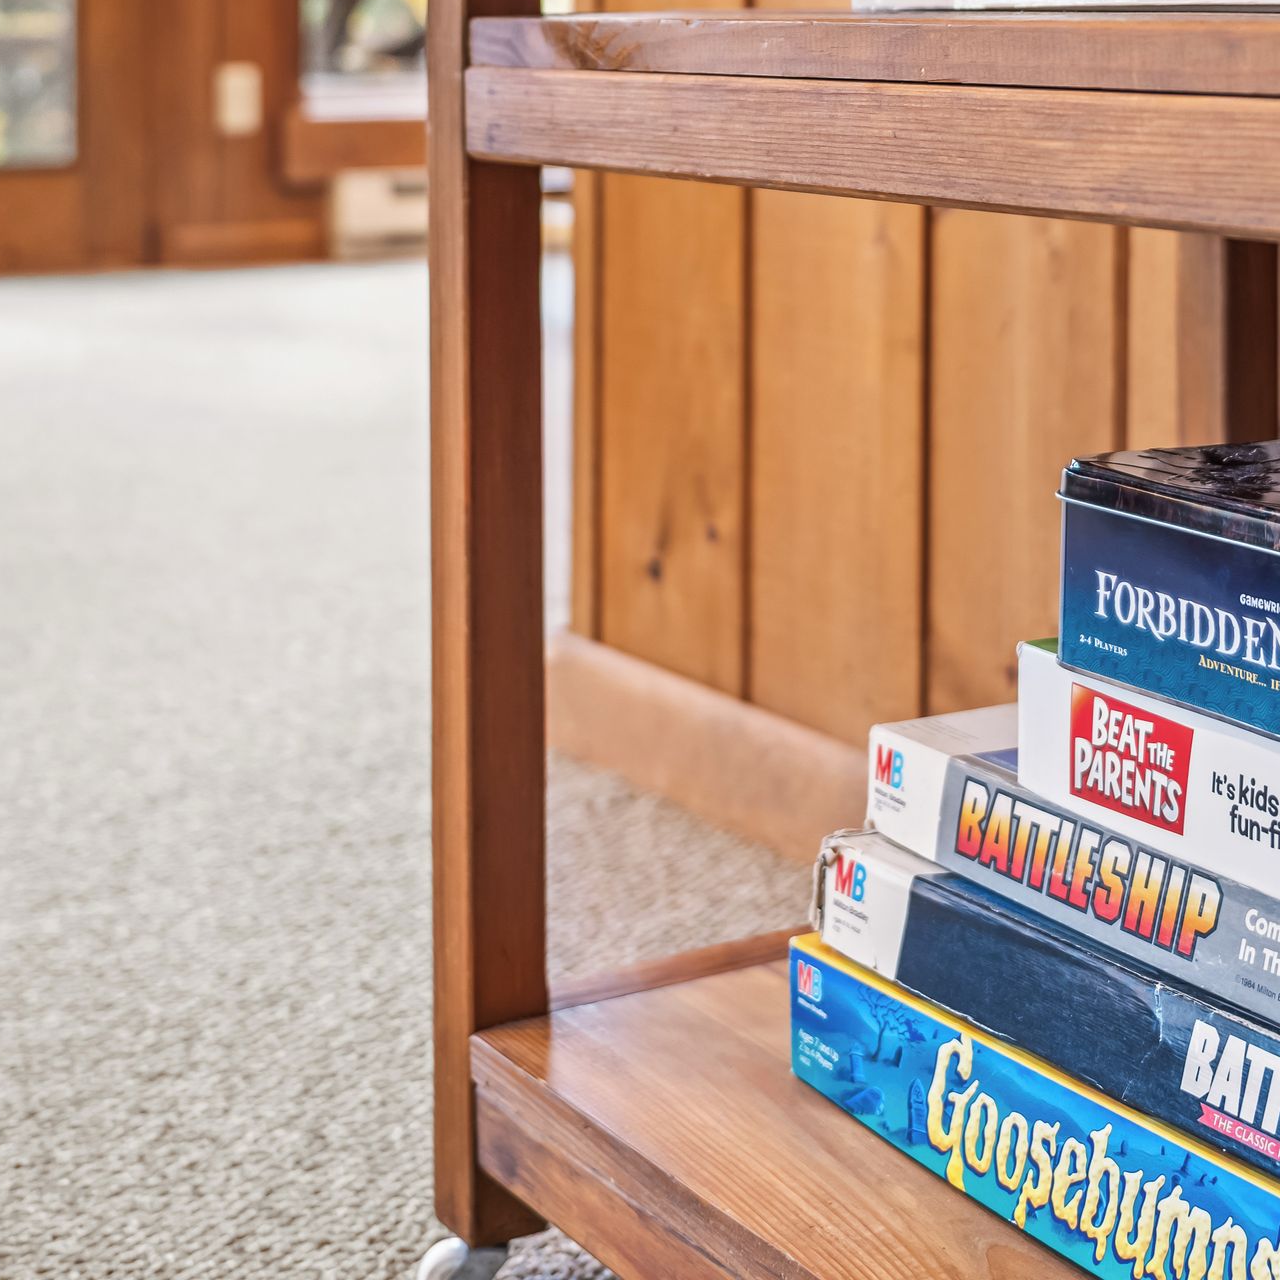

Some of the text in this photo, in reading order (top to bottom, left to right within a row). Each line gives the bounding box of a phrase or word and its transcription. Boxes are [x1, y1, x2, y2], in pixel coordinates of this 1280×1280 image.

[1079, 633, 1093, 644] 2-4
[1092, 696, 1175, 772] BEAT THE
[875, 743, 904, 790] MB
[1074, 736, 1183, 823] PARENTS
[1211, 771, 1236, 800] It's
[1238, 774, 1279, 817] kids
[835, 854, 867, 902] MB
[955, 775, 1224, 962] BATTLESHIP
[1238, 938, 1256, 965] In
[1257, 984, 1276, 1000] Milton
[1212, 1113, 1232, 1133] THE
[1235, 1123, 1276, 1155] CLASSIC
